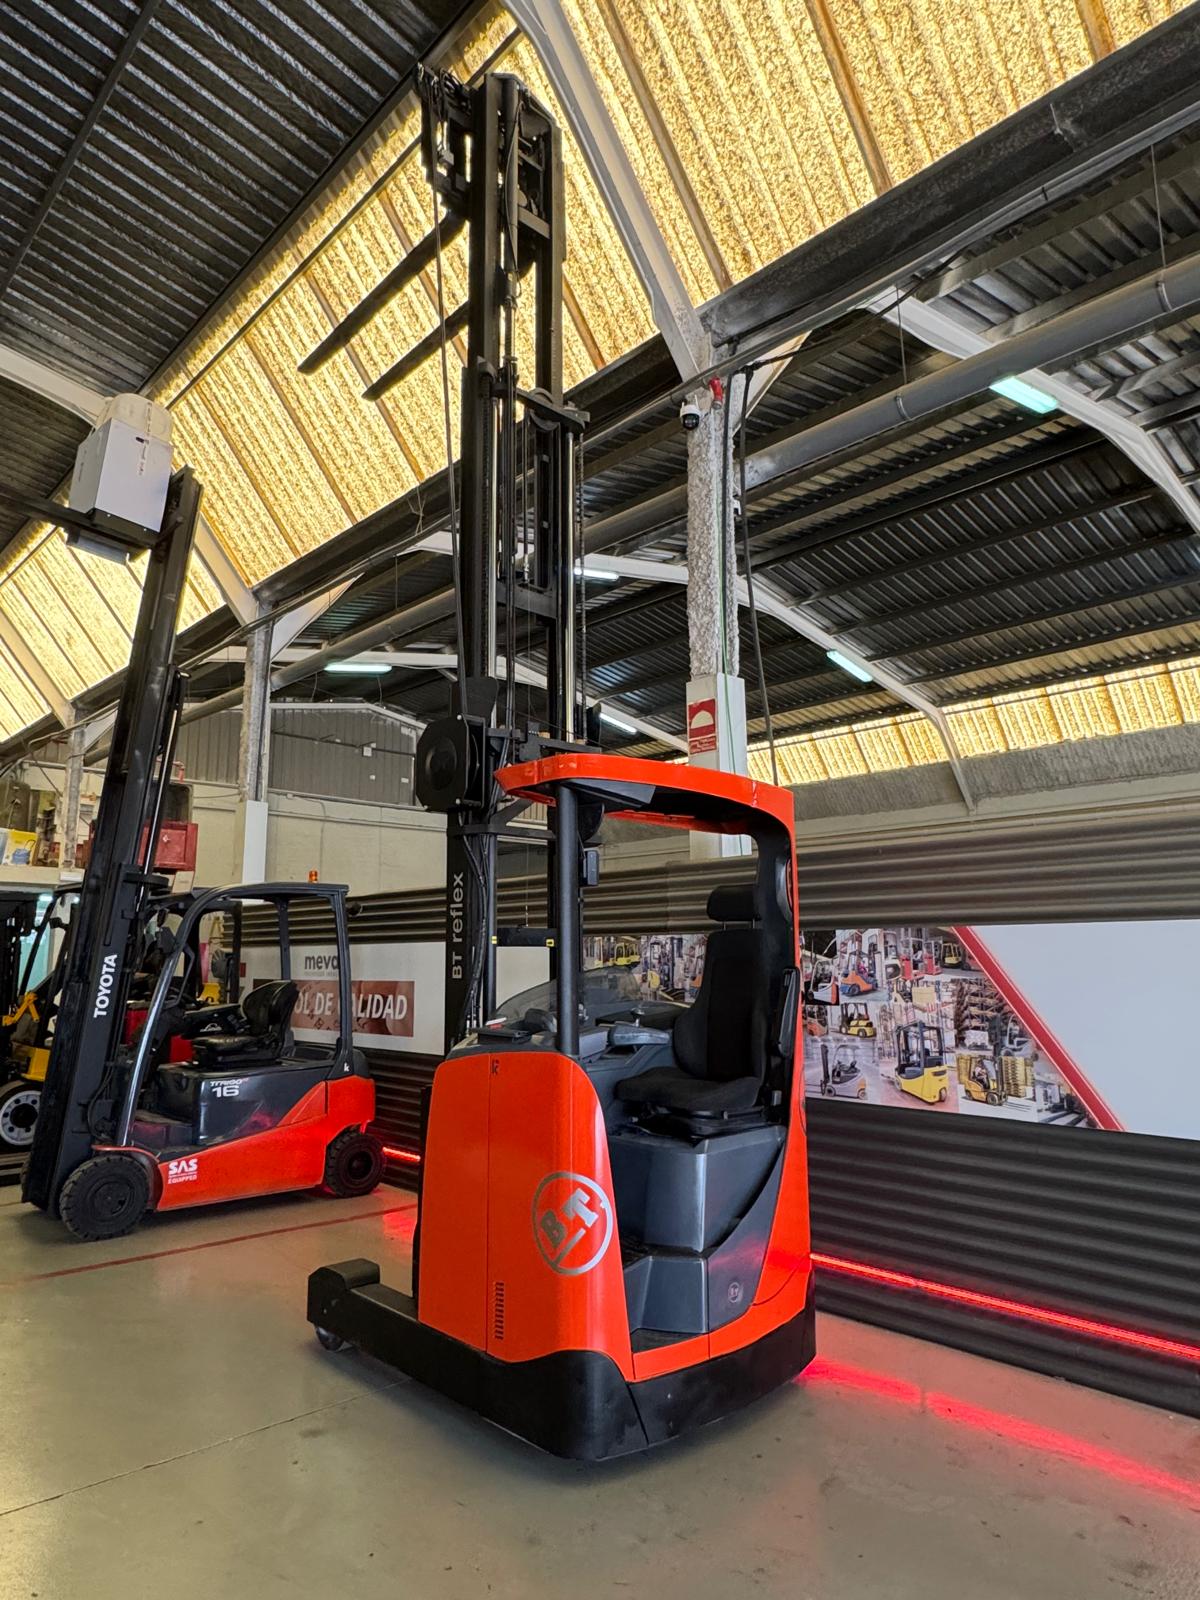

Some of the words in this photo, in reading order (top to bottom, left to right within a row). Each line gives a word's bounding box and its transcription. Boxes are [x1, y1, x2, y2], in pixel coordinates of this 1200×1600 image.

[450, 872, 463, 942] reflex
[452, 952, 462, 979] BT
[93, 954, 118, 1018] TOYOTA
[314, 992, 334, 1015] DE
[212, 1085, 240, 1098] 16
[168, 1159, 198, 1175] SAS
